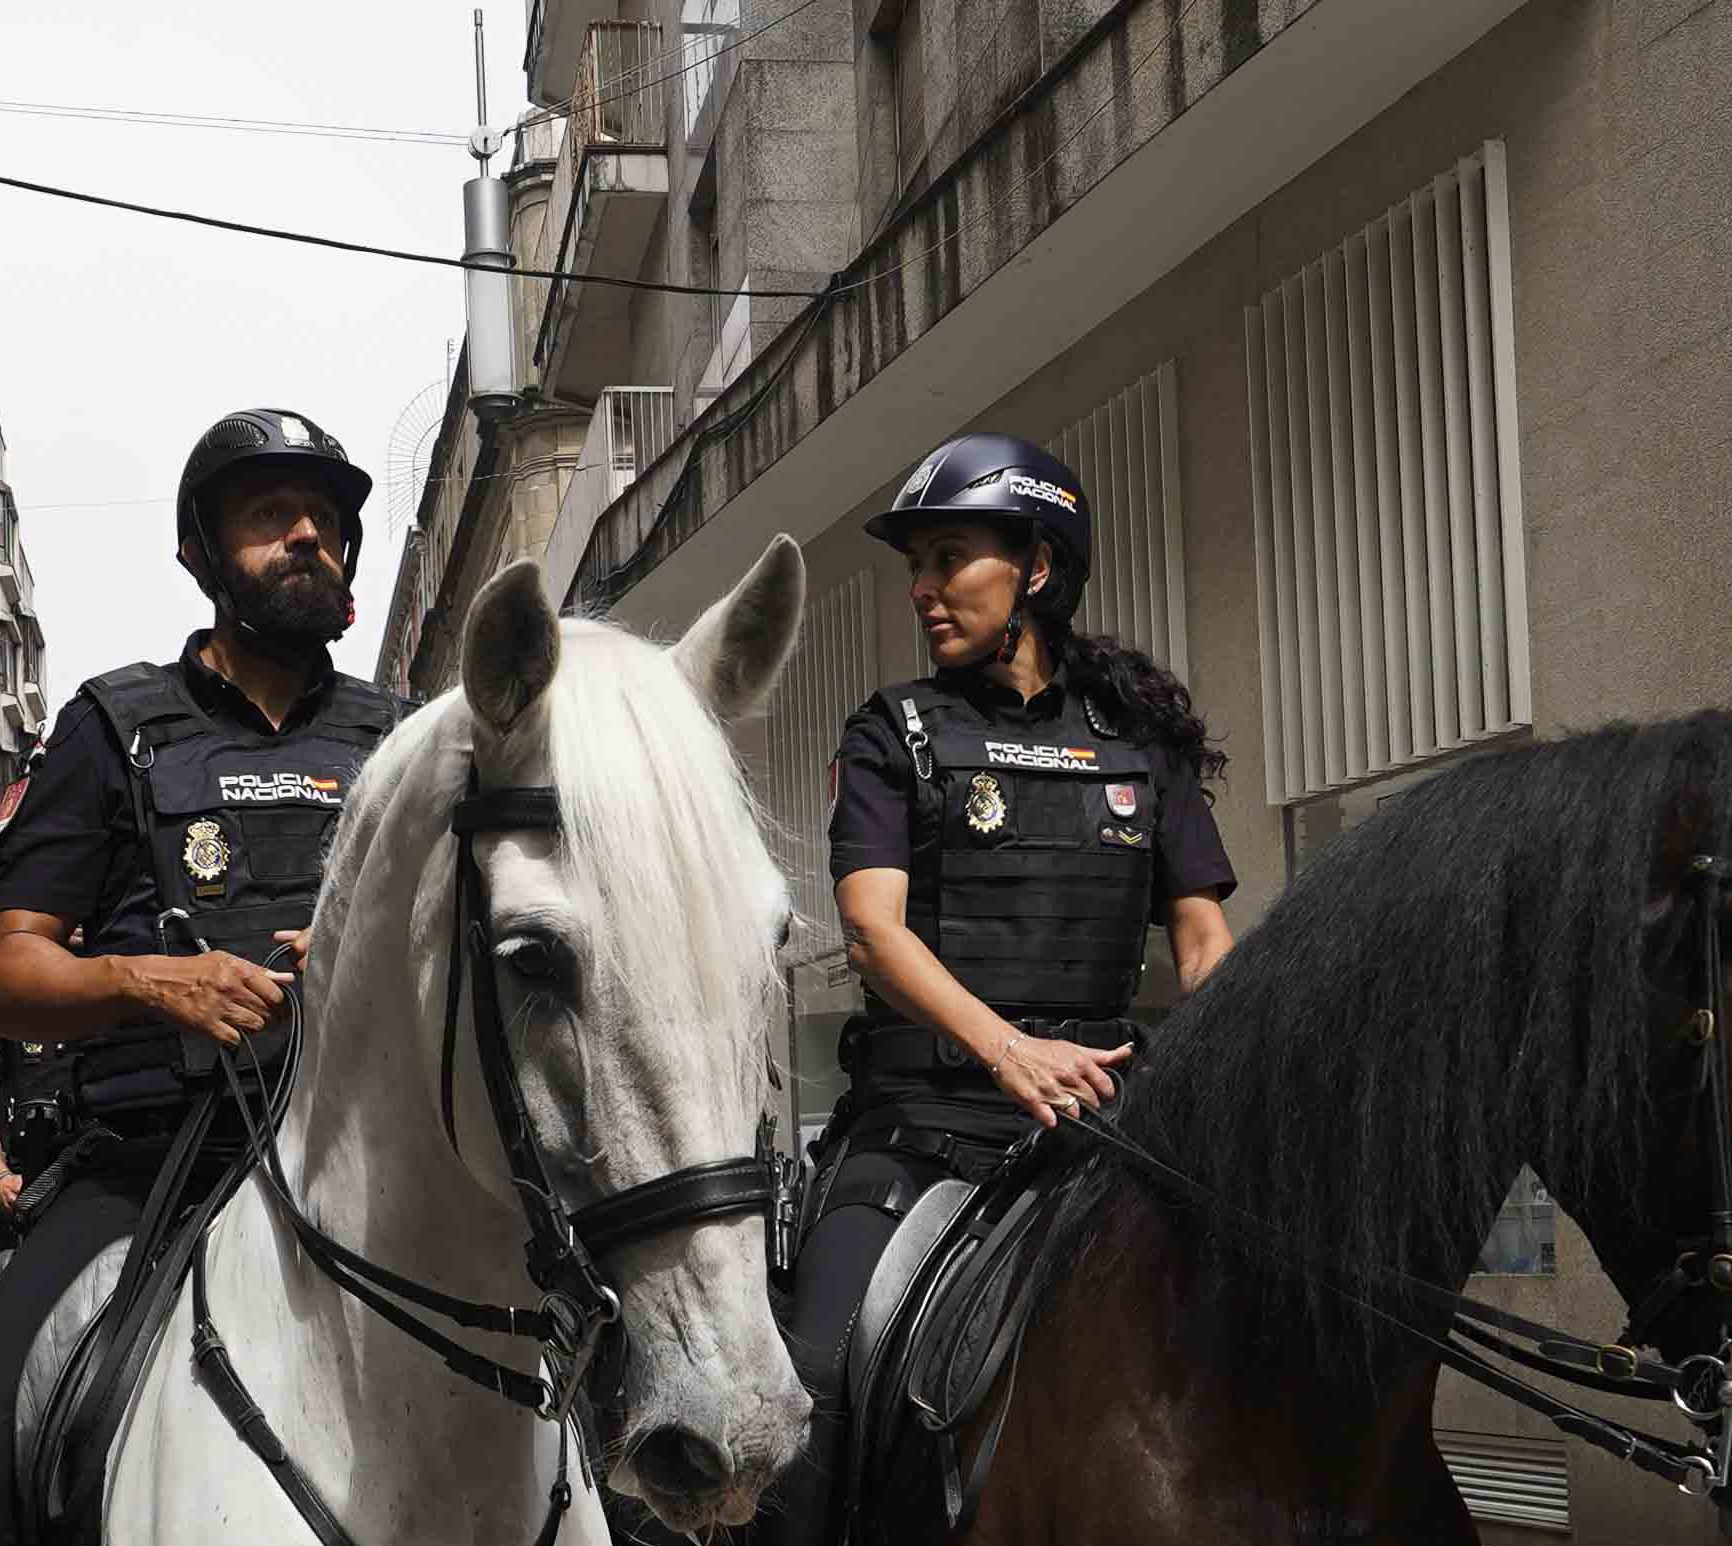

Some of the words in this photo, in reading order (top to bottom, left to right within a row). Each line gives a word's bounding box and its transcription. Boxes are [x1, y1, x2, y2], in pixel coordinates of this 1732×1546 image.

[1009, 475, 1064, 495] POLICIA
[1009, 485, 1076, 514] NACIONAL
[985, 742, 1074, 758] POLICIA
[988, 752, 1099, 771] NACIONAL
[219, 773, 316, 789] POLICIA
[222, 785, 341, 803] NACIONAL
